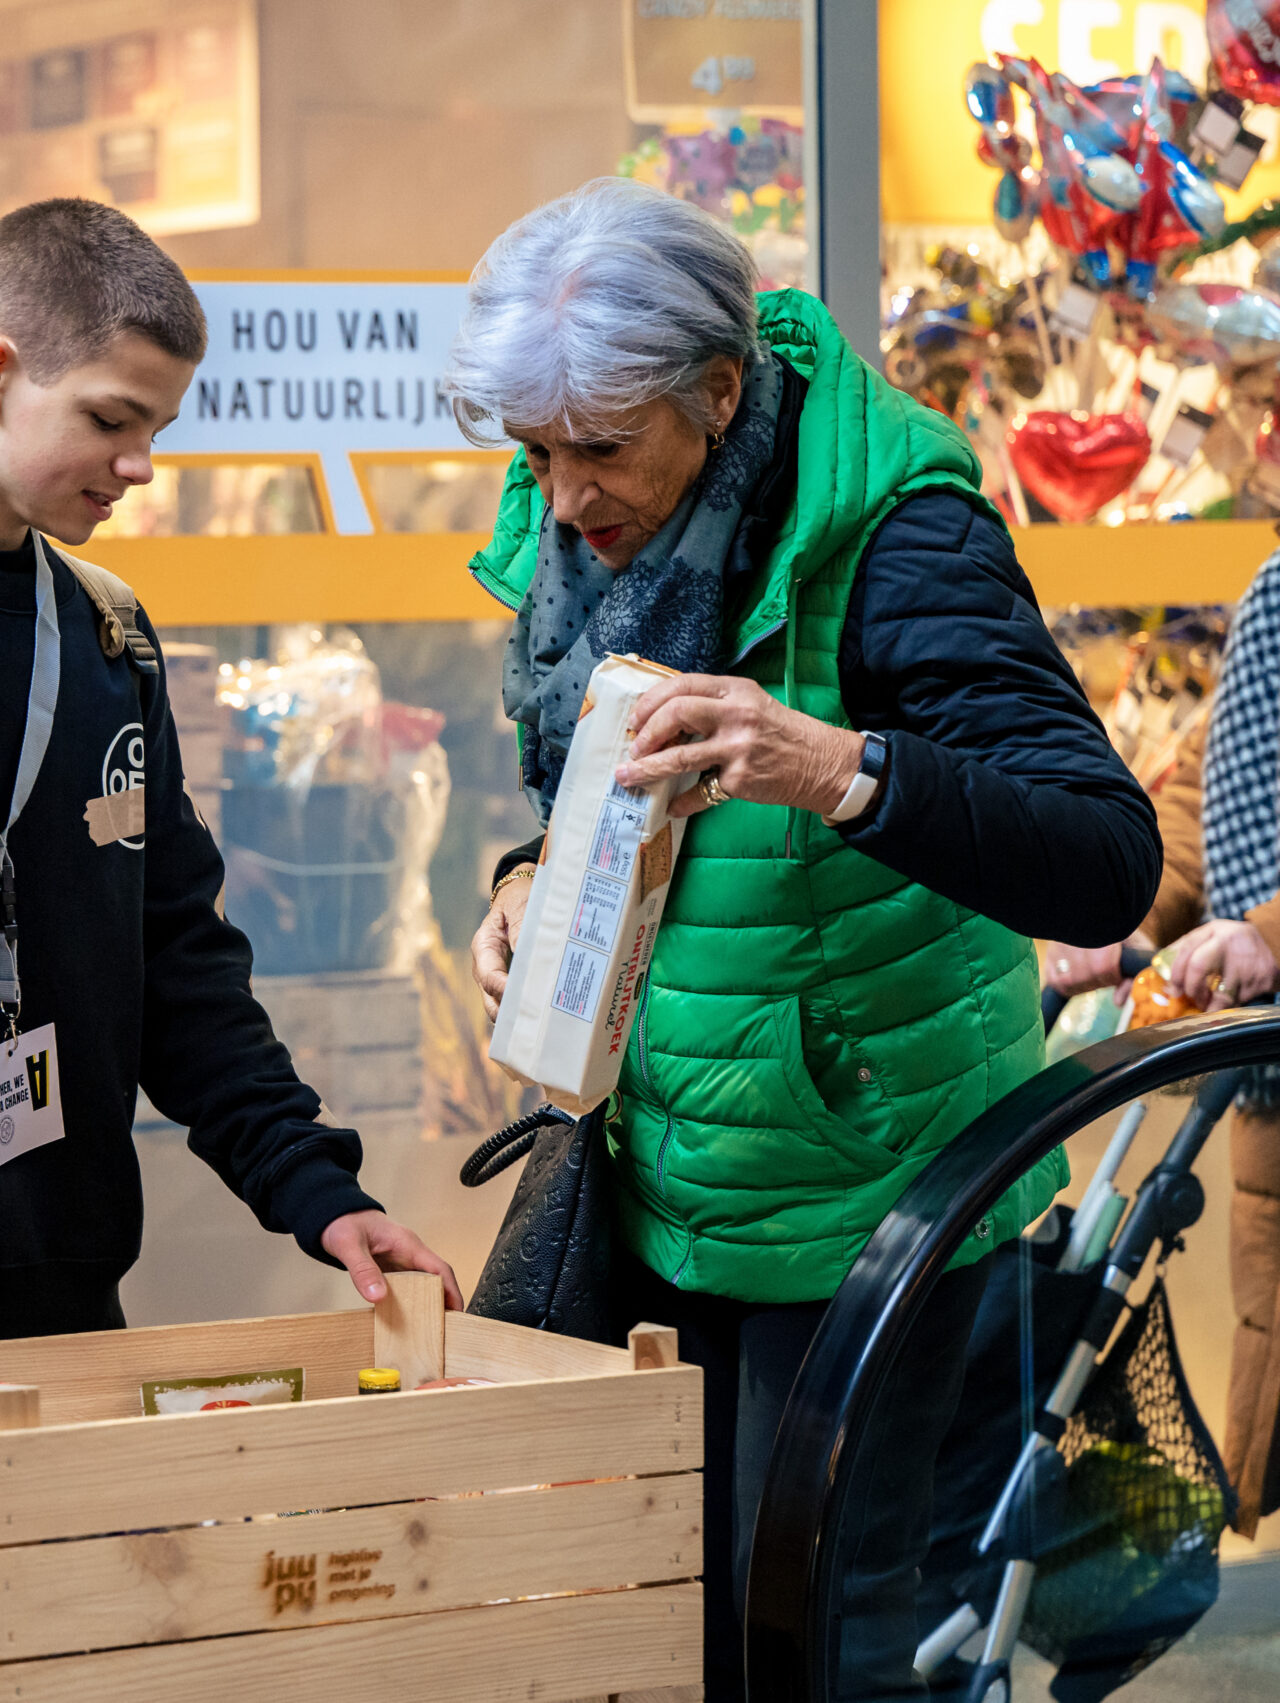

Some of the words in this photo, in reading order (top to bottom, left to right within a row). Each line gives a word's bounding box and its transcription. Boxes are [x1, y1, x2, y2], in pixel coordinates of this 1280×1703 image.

[232, 309, 317, 352] HOU
[338, 309, 418, 352] VAN
[607, 924, 645, 1057] ONTBIJTKOEK
[13, 1073, 25, 1090] WE
[0, 1100, 4, 1111] A
[4, 1088, 29, 1110] CHANGE
[328, 1584, 396, 1601] omgeving
